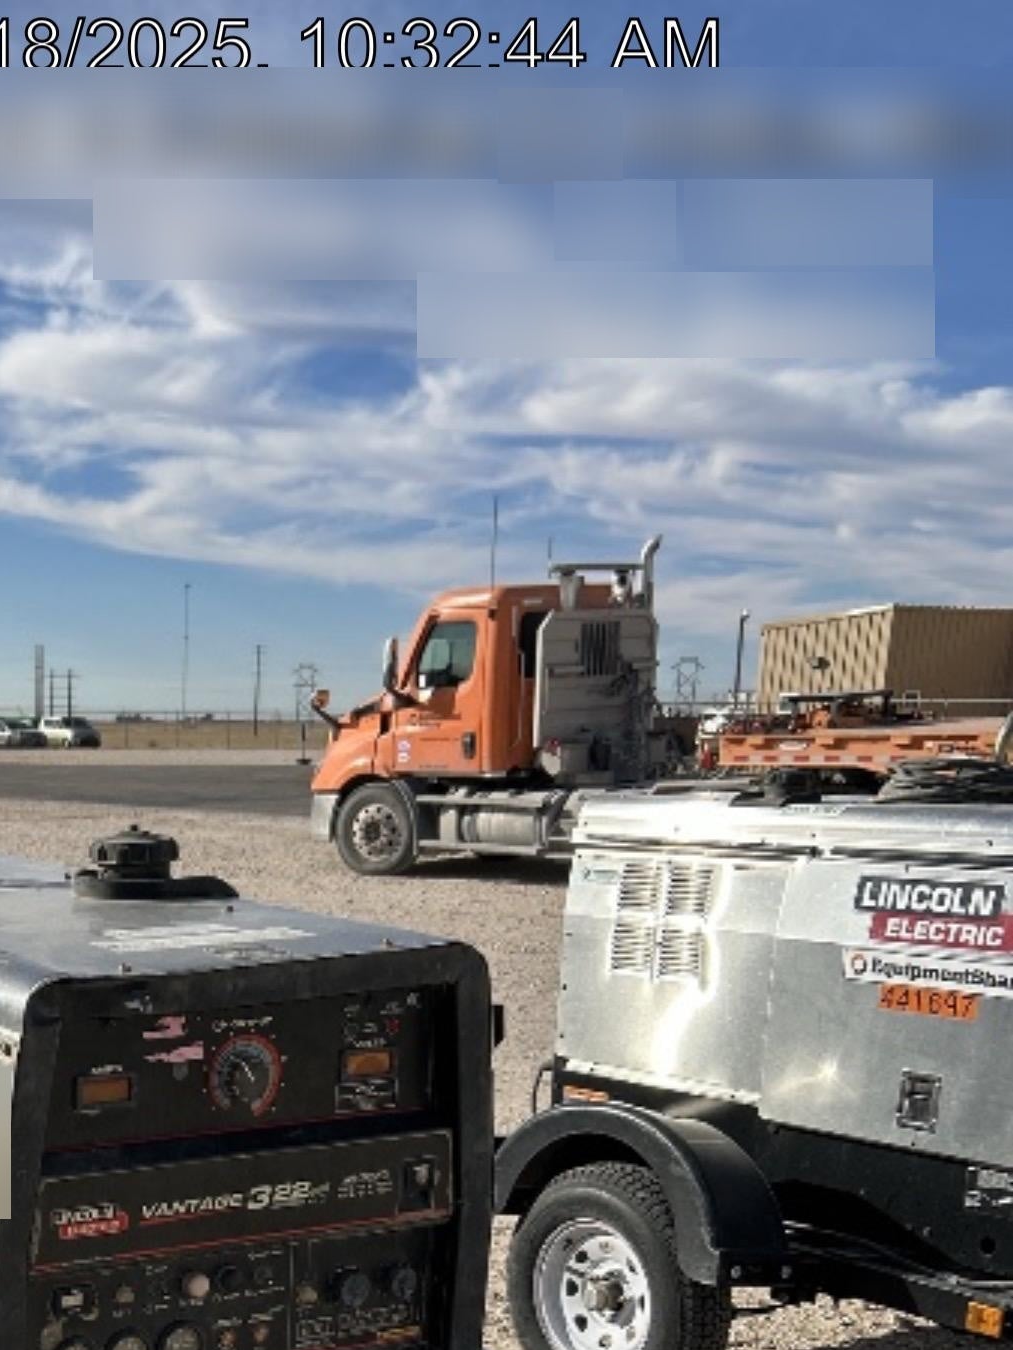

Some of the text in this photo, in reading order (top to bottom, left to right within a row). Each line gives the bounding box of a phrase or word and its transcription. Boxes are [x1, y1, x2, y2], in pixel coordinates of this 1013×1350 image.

[861, 881, 996, 916] LINCOLN
[884, 917, 1005, 946] ELECTRIC
[142, 1192, 244, 1219] VANTAGE
